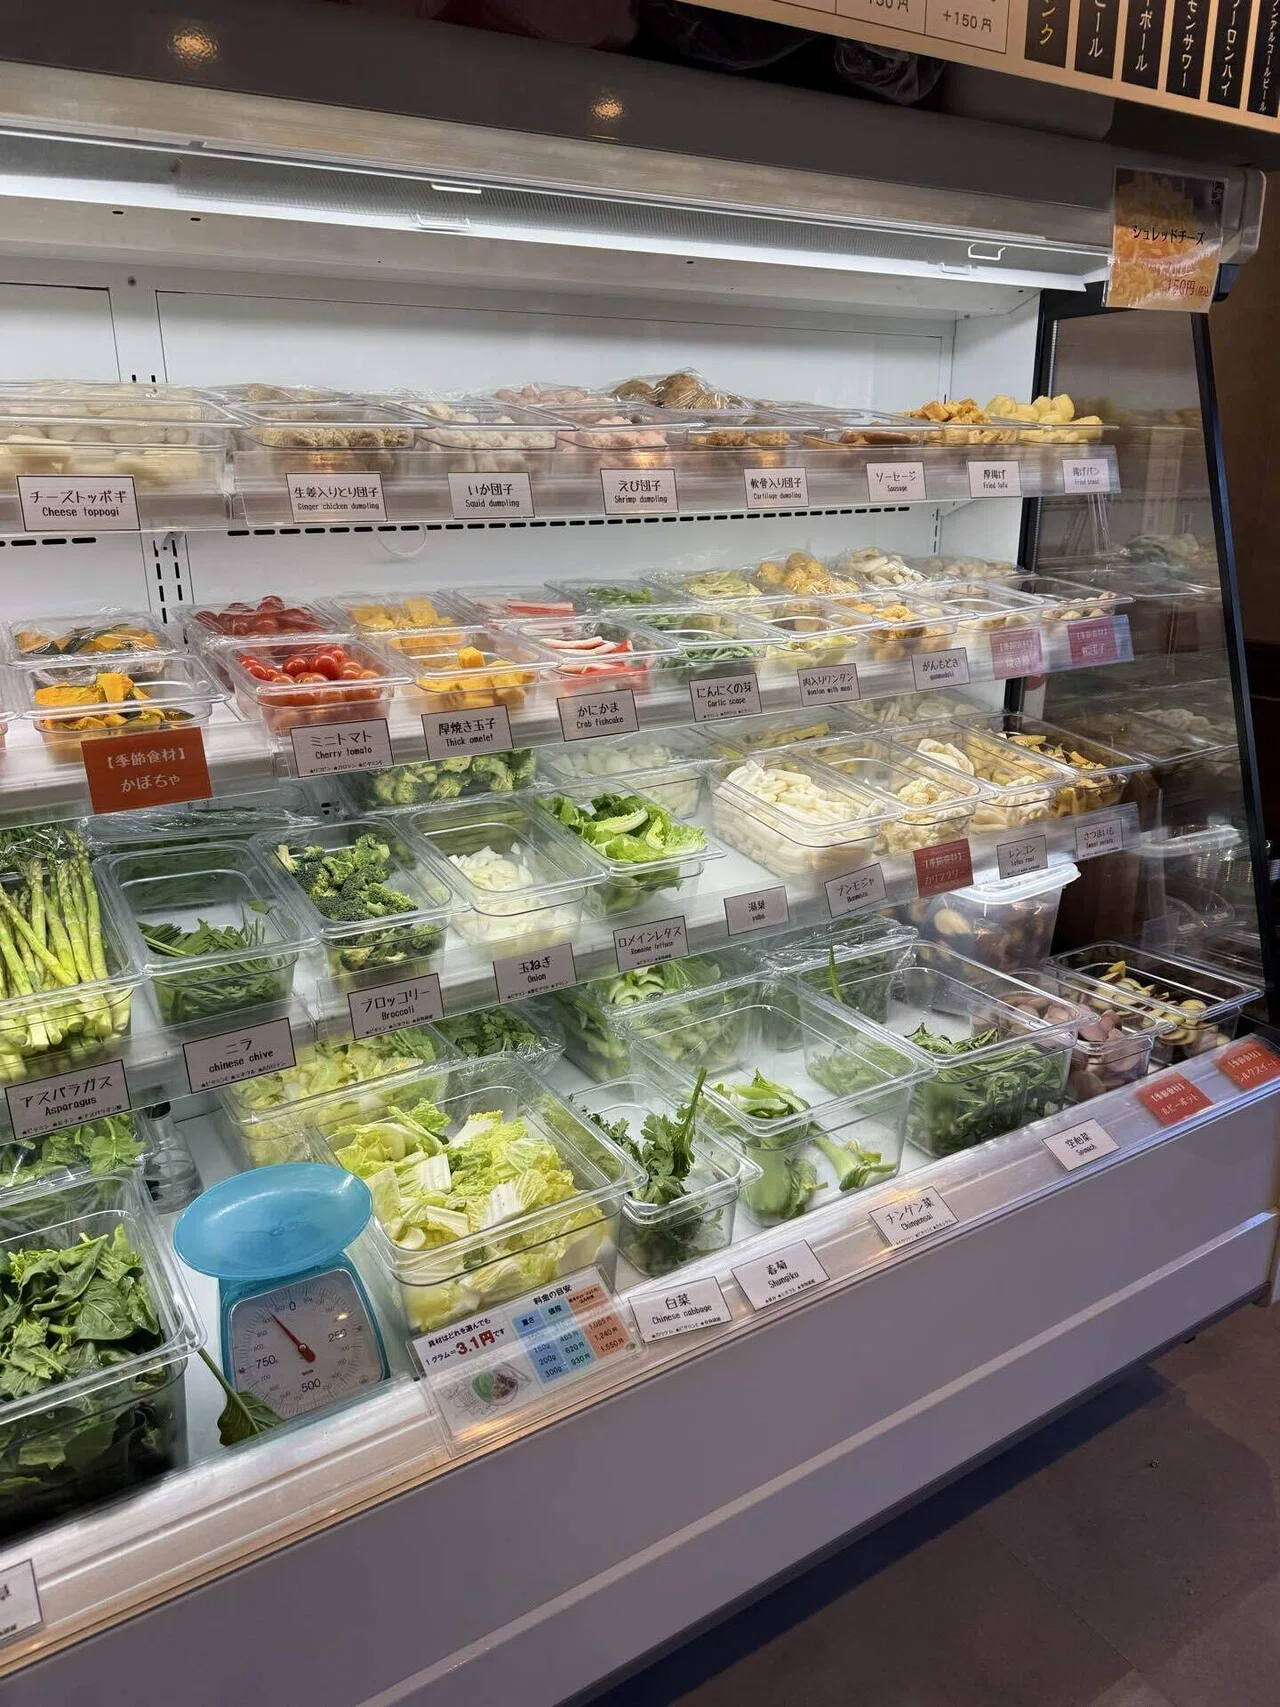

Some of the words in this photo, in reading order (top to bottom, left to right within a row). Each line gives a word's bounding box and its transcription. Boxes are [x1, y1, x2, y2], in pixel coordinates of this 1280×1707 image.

[1132, 225, 1206, 247] シュレッドチーズ
[750, 477, 802, 490] 軟骨入り団子
[876, 471, 917, 483] ソーセージ
[294, 486, 379, 498] 生姜入りとり団子
[467, 483, 514, 496] いか団子
[619, 479, 661, 492] えび団子
[30, 490, 128, 505] チーズトッポギ
[465, 499, 486, 508] Squid
[489, 499, 520, 508] dumpling
[614, 495, 637, 504] Shrimp
[639, 495, 668, 504] dumpling
[42, 506, 78, 517] Cheese
[297, 502, 319, 511] Ginger
[323, 501, 348, 510] chicken
[351, 501, 380, 511] dumpling
[922, 658, 959, 672] がんもどき
[696, 681, 753, 699] にんにくの芽
[577, 701, 620, 718] かにかま
[438, 717, 497, 737] 厚焼き玉子
[576, 720, 592, 730] Crab
[310, 730, 373, 747] ミニトマト
[445, 737, 466, 748] Thick
[469, 733, 494, 744] omelet
[107, 747, 186, 769] 【季節食材】
[315, 749, 343, 761] Cherry
[346, 746, 373, 756] tomato
[121, 773, 181, 793] かぼちゃ
[618, 926, 682, 948] ロメインレタス
[654, 940, 674, 951] lettuce
[518, 955, 552, 975] 玉ねぎ
[527, 972, 547, 984] Onion
[361, 988, 431, 1013] ブロッコリー
[381, 1004, 415, 1020] Broccoli
[225, 1039, 253, 1055] ニラ
[208, 1055, 245, 1073] chinese
[249, 1048, 274, 1063] chive
[20, 1075, 113, 1108] アスパラガス
[44, 1095, 98, 1117] Asparagus
[886, 1197, 935, 1224] チンゲン菜
[767, 1271, 800, 1289] Shungiku
[532, 1285, 573, 1306] 料金の目安
[665, 1293, 689, 1311] 白菜
[289, 1301, 297, 1311] 0
[651, 1312, 681, 1326] Chinese
[683, 1304, 713, 1318] cabbage
[328, 1328, 348, 1343] 250
[256, 1354, 277, 1369] 750
[301, 1378, 322, 1393] 500
